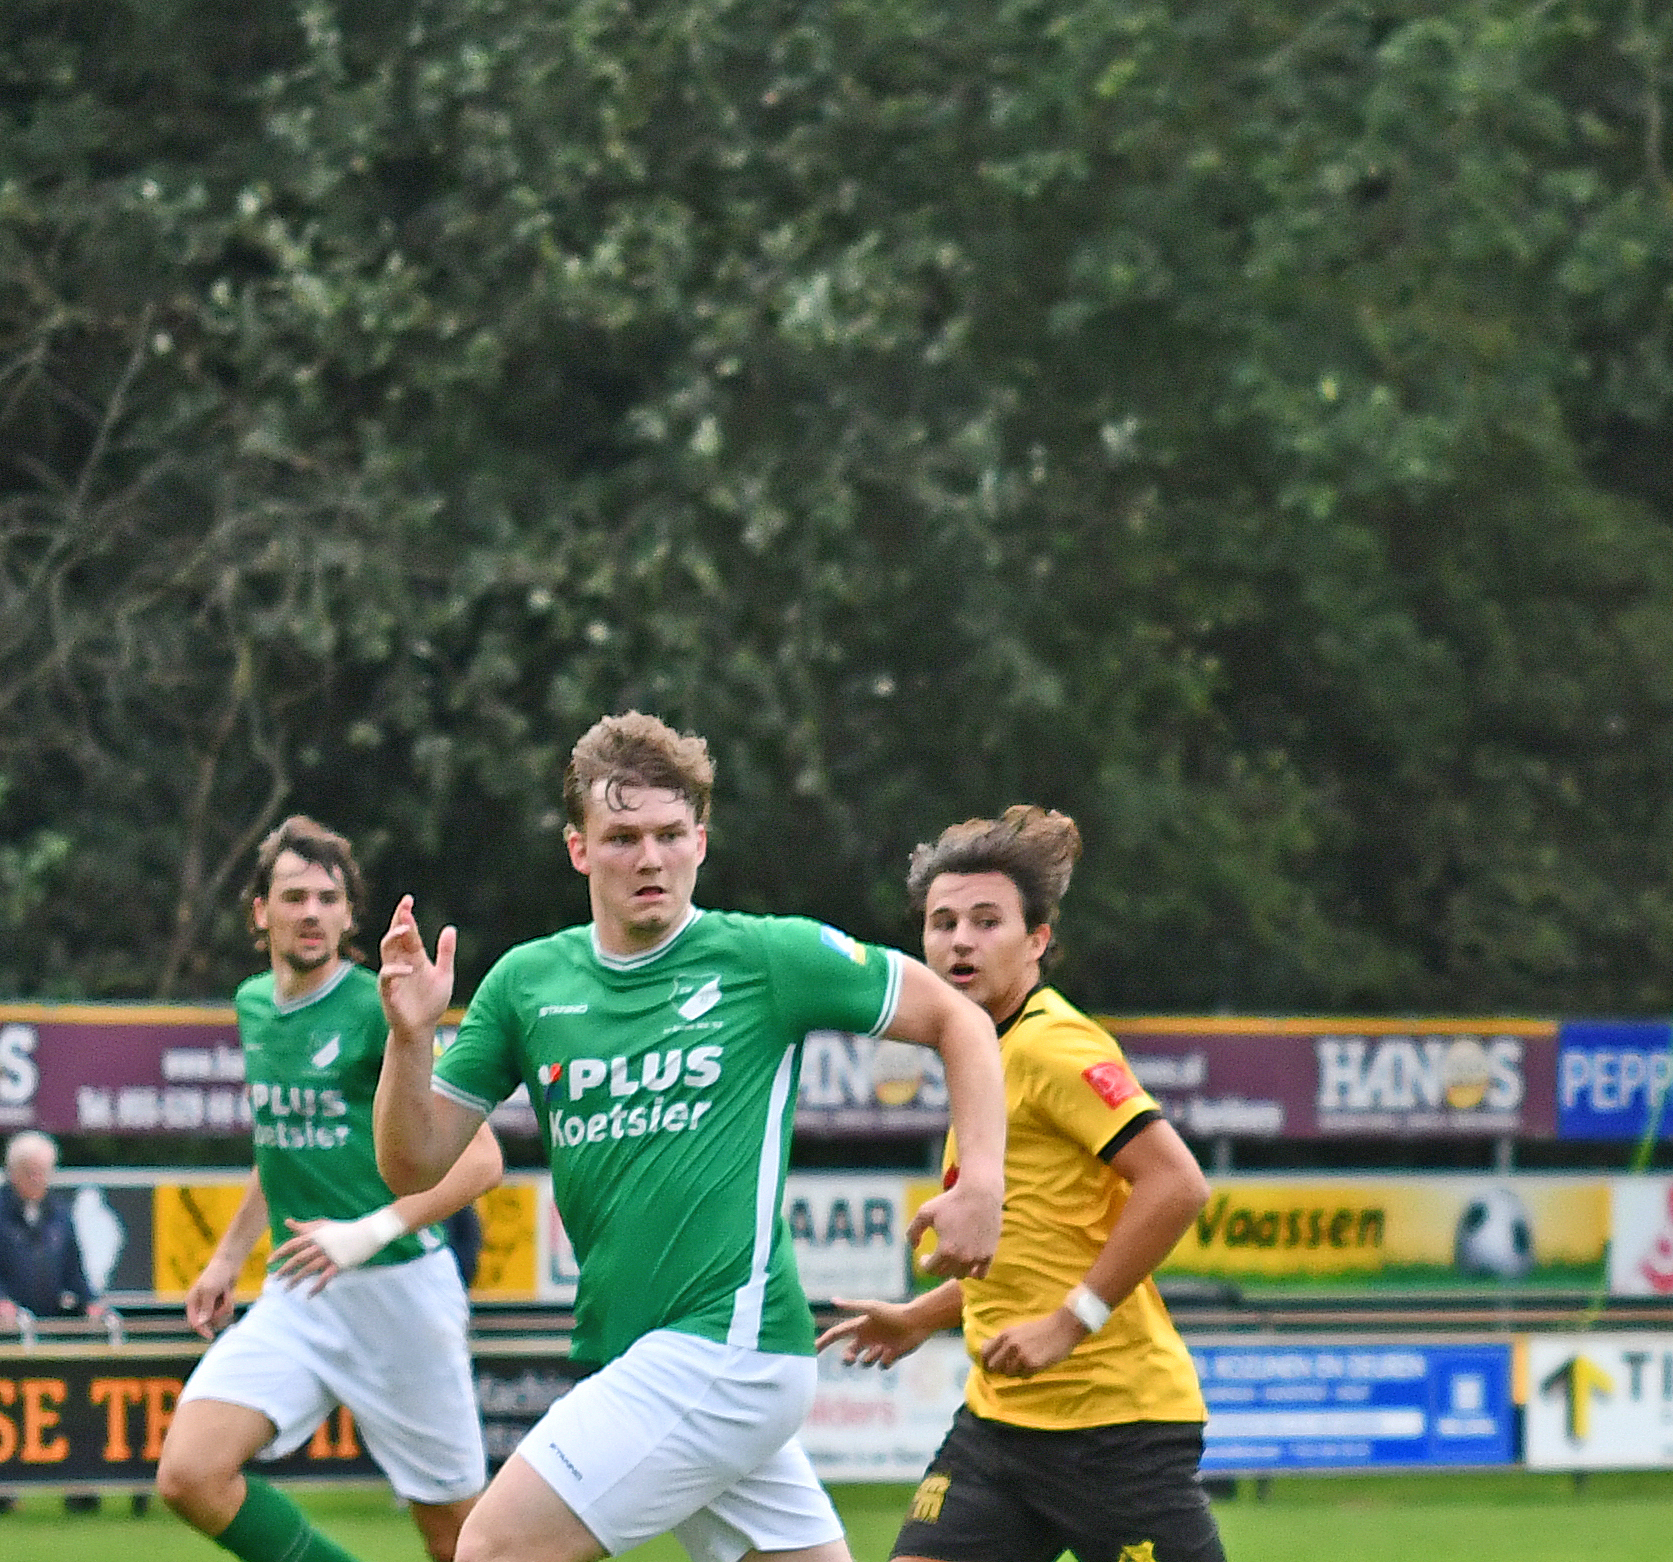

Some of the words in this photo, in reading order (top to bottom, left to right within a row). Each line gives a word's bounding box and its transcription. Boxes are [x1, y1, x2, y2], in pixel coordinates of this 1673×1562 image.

[569, 1046, 724, 1102] PLUS
[1316, 1034, 1526, 1110] HANOS
[252, 1083, 347, 1118] PLUS
[550, 1096, 713, 1149] Koetsier
[254, 1121, 350, 1151] etsier
[1198, 1195, 1385, 1248] Vaassen
